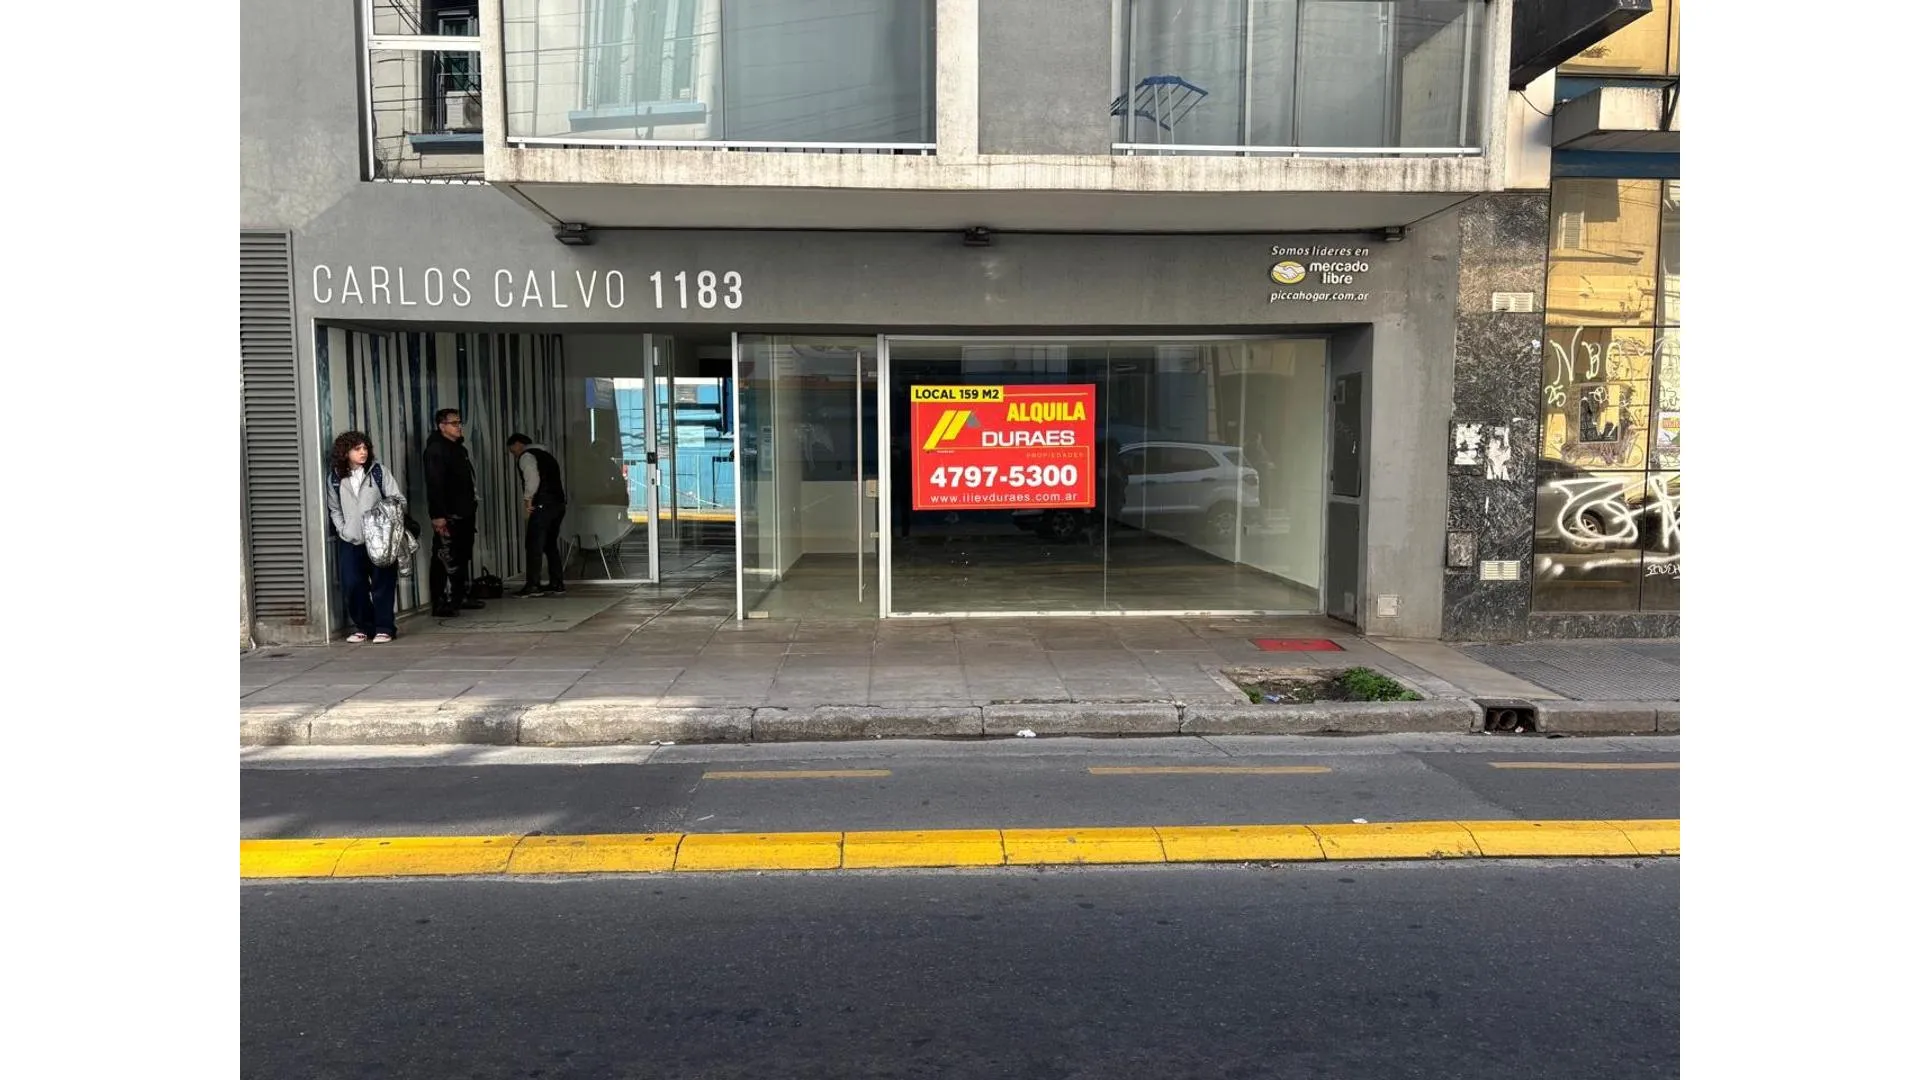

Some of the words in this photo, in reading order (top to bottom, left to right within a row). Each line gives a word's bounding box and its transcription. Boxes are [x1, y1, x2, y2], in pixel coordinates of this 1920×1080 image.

[1271, 245, 1309, 257] Somos
[1354, 249, 1369, 257] en
[1309, 260, 1369, 272] mercado
[1322, 272, 1353, 285] libre
[312, 264, 472, 307] CARLOS
[494, 269, 626, 309] CALVO
[649, 270, 744, 310] 1183
[1270, 290, 1369, 304] piccahogar.com.ar
[915, 389, 956, 400] LOCAL
[959, 389, 979, 400] 159
[982, 389, 1000, 400] M2
[1006, 401, 1086, 424] ALQUILA
[982, 430, 1075, 447] DURAES
[930, 464, 1078, 487] 4797-5300
[930, 493, 1078, 503] www.ilievduraes.com.ar
